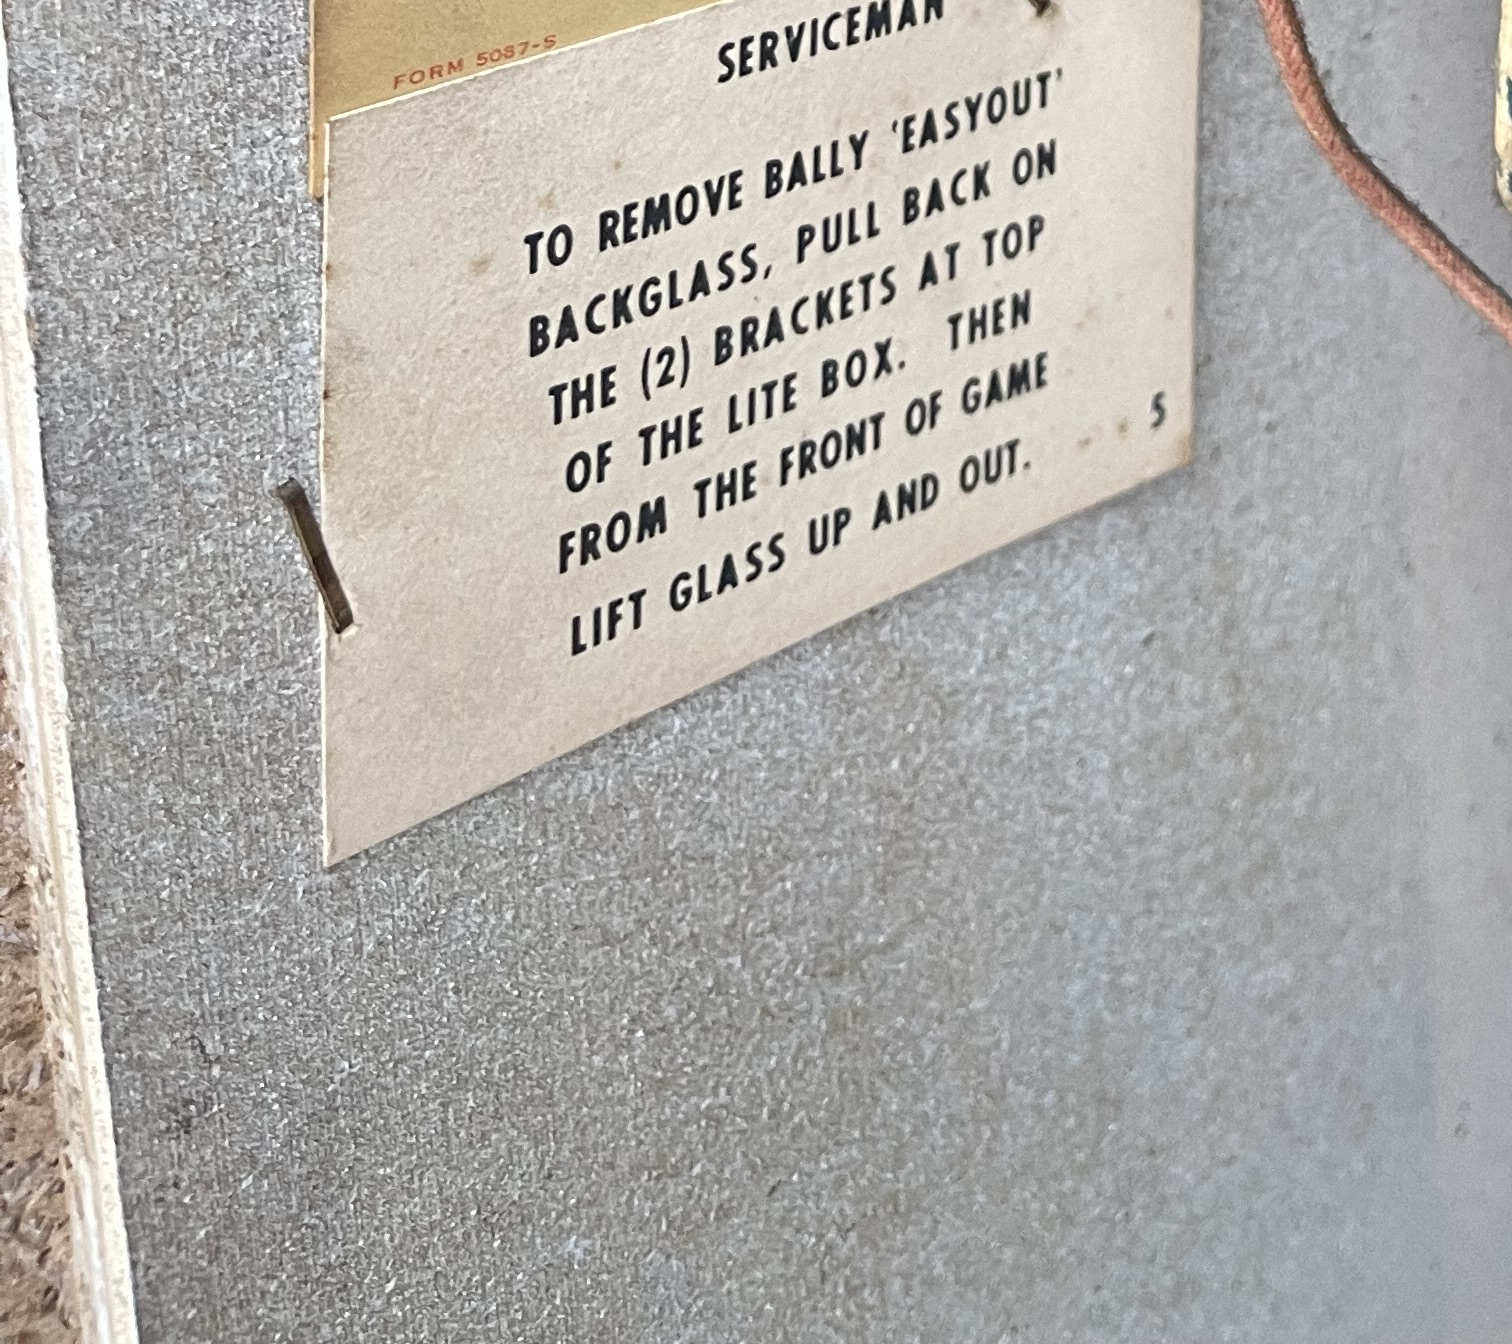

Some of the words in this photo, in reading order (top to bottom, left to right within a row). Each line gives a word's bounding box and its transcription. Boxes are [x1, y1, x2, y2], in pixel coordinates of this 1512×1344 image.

[393, 58, 464, 90] FORM
[523, 224, 573, 274] TO
[598, 169, 743, 254] REMOVE
[765, 130, 869, 199] BALLY
[529, 243, 772, 358] BACKGLASS,
[796, 201, 880, 264] PULL
[902, 160, 991, 226] BACK
[1012, 138, 1056, 187] ON
[548, 365, 617, 425] THE
[641, 335, 690, 401] (2)
[714, 265, 896, 366] BRACKETS
[918, 242, 961, 292] AT
[982, 215, 1045, 267] TOP
[565, 440, 613, 493] OF
[638, 407, 704, 466] THE
[728, 372, 797, 434] LITE
[821, 336, 905, 399] BOX.
[947, 289, 1031, 352] THEN
[1150, 391, 1166, 430] 5
[559, 496, 667, 574] FROM
[693, 460, 757, 520] THE
[780, 411, 885, 488] FRONT
[905, 389, 943, 437] OF
[961, 351, 1048, 416] GAME
[571, 588, 647, 656] LIFT
[669, 532, 786, 612] GLASS
[808, 507, 852, 556] UP
[872, 472, 939, 531] AND
[959, 438, 1031, 494] OUT.
